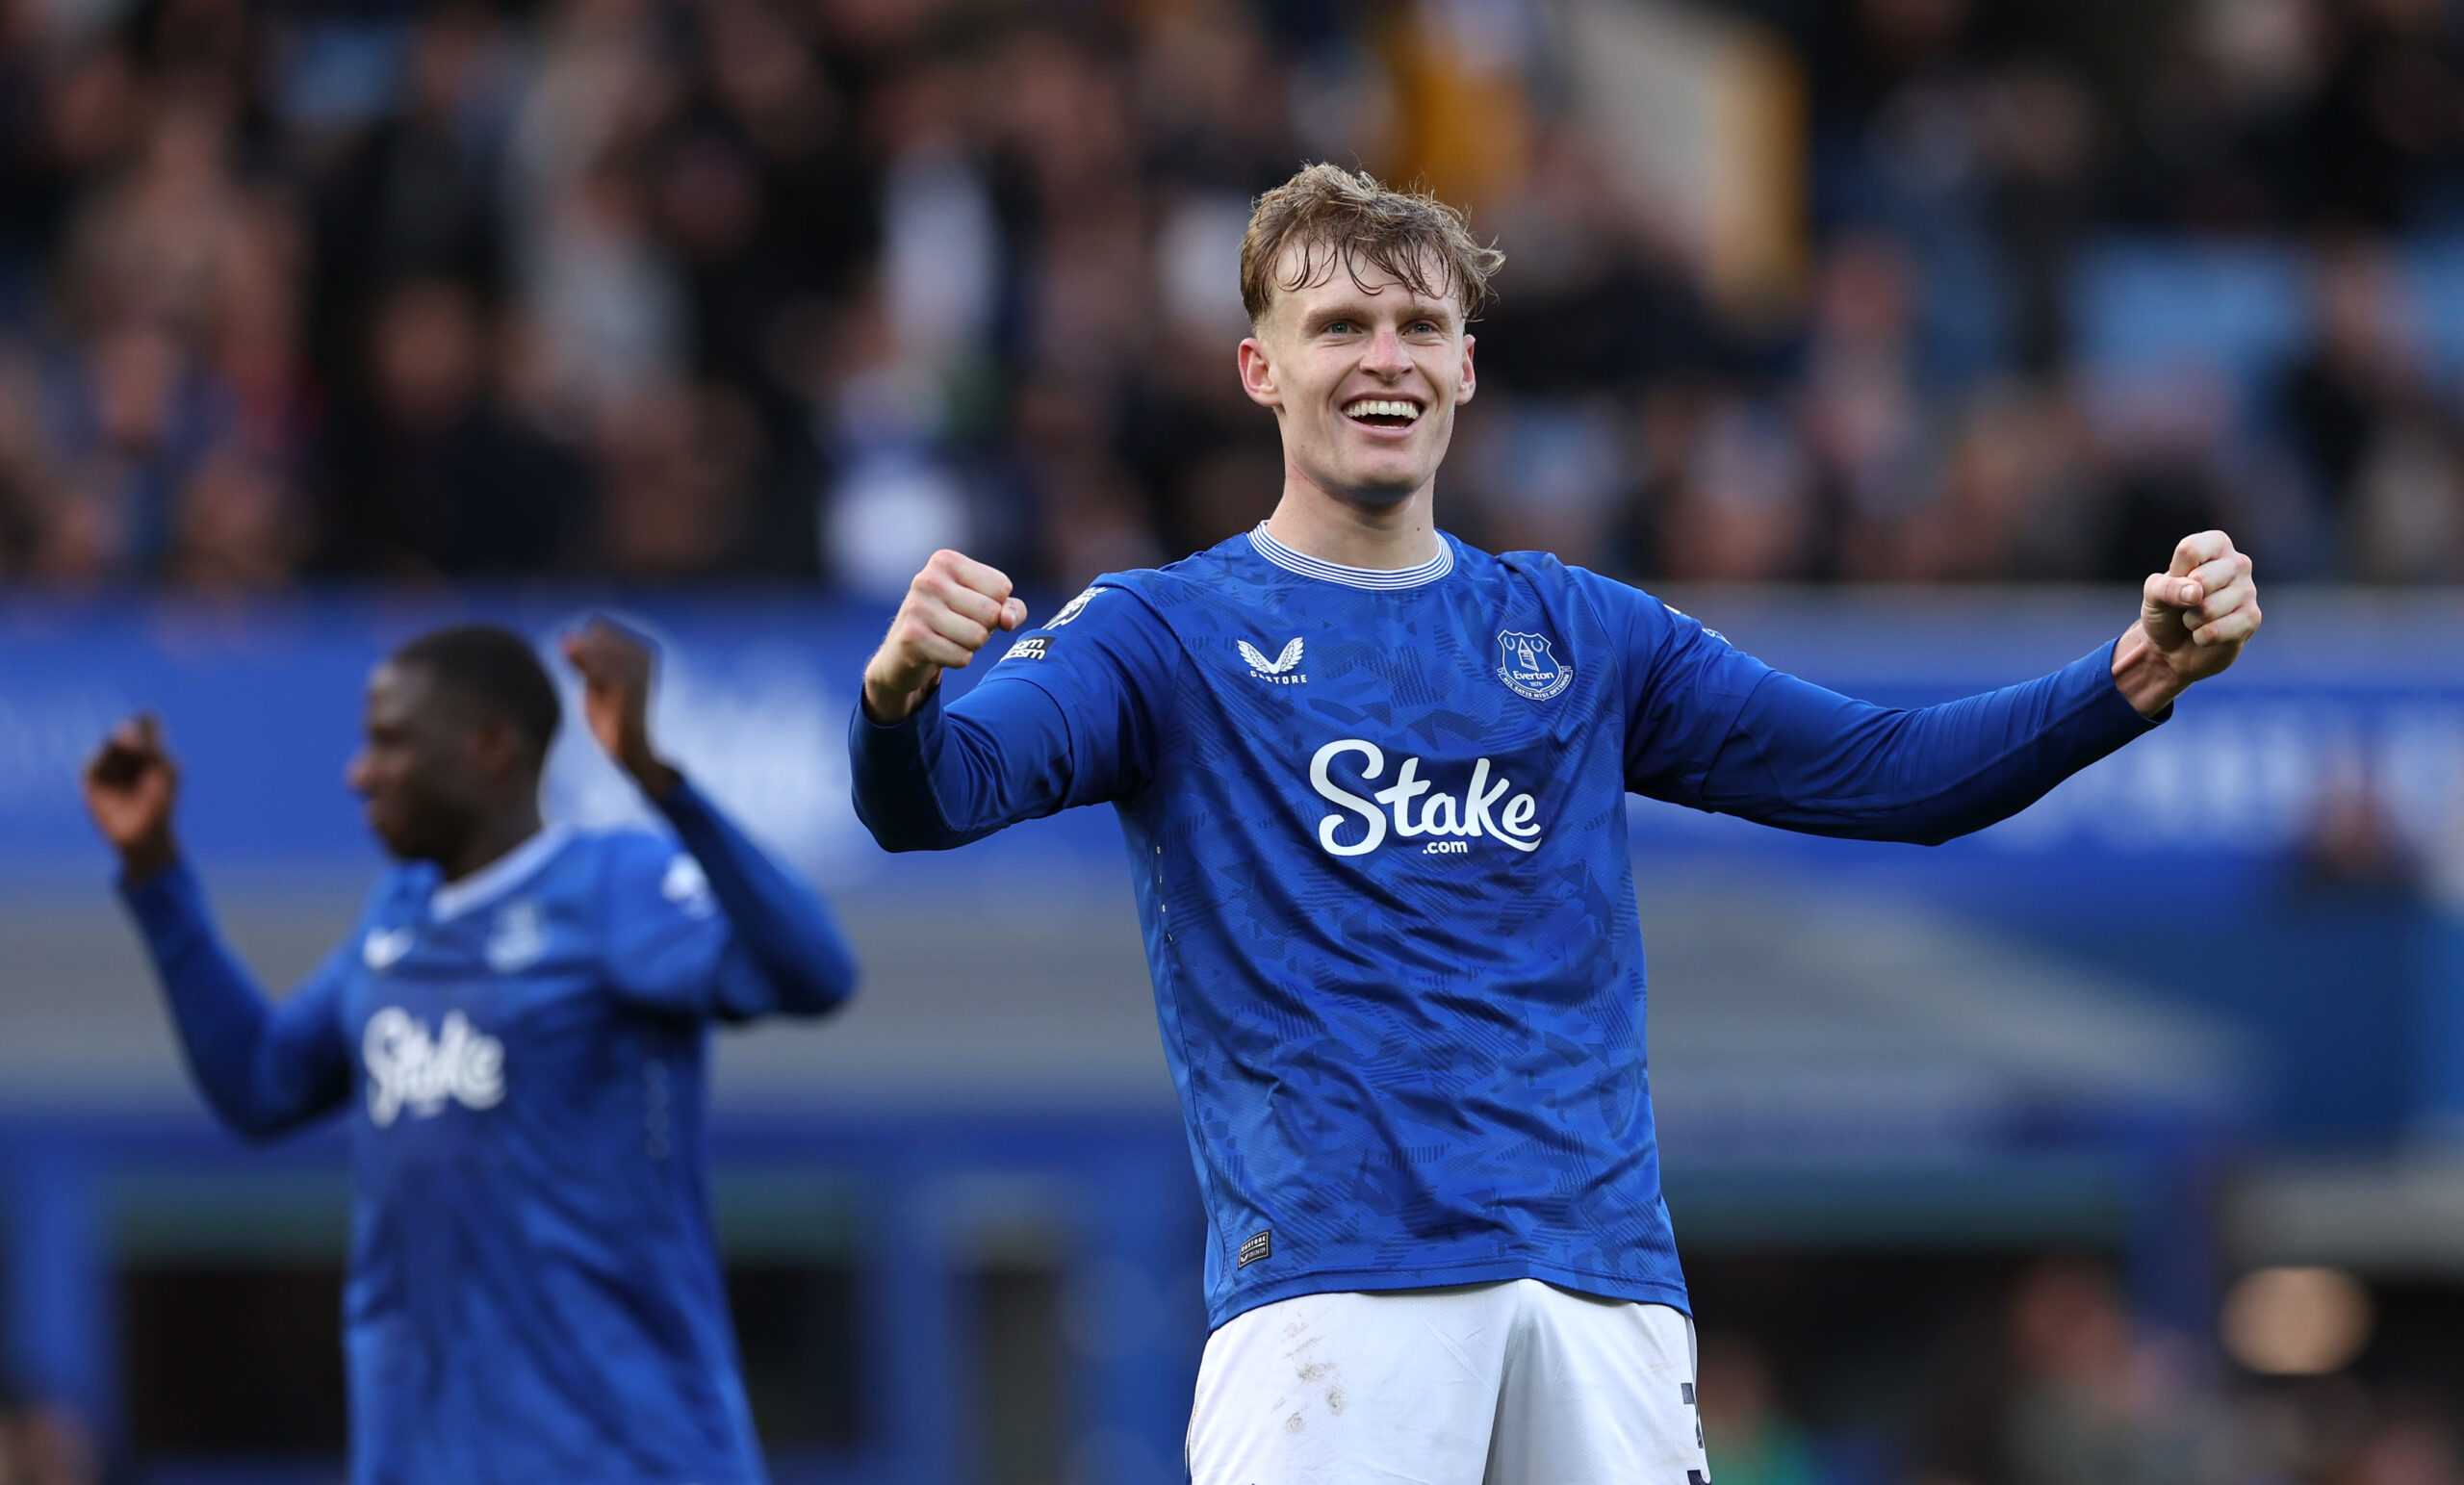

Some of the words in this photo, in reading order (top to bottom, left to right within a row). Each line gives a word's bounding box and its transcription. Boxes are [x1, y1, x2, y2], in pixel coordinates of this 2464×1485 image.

[1513, 671, 1554, 679] Everton
[1310, 739, 1541, 856] Stake
[1422, 840, 1469, 855] .com
